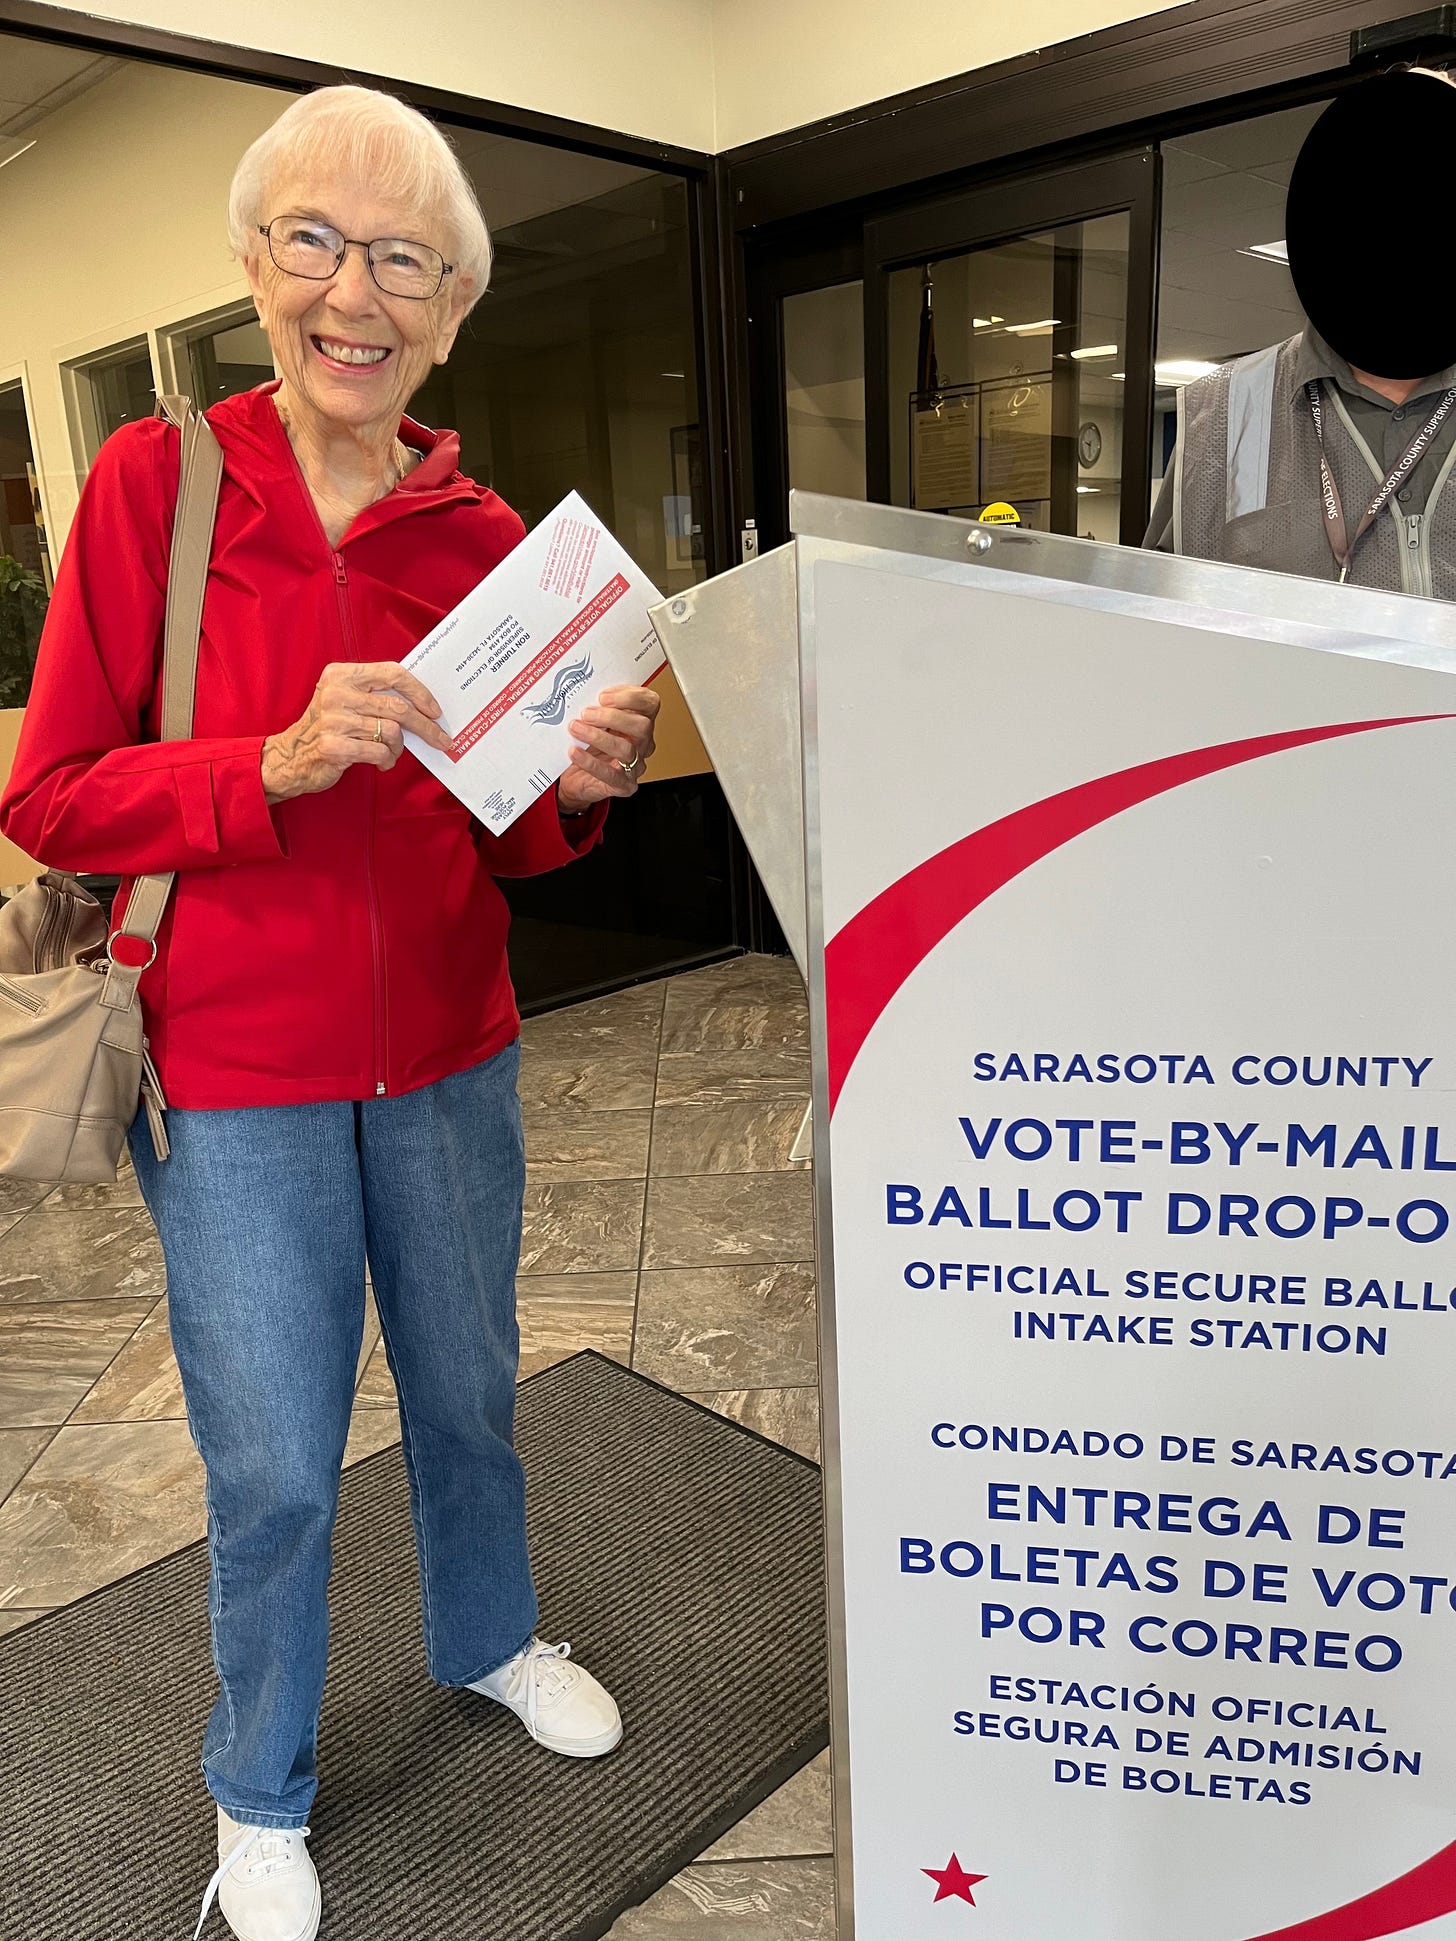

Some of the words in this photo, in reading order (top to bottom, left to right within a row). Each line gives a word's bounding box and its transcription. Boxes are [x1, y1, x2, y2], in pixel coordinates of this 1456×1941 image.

[1368, 471, 1404, 515] SARASOTA
[1399, 433, 1428, 470] COUNTY
[1424, 386, 1456, 435] SUPERVISO
[1320, 471, 1338, 520] ELECTIONS
[982, 513, 1015, 522] AUTOMATIC
[597, 584, 624, 612] OFFICIAL
[485, 613, 513, 642] SARASOTA
[508, 619, 519, 630] PO
[561, 608, 601, 648] VOTE-BY-MAIL
[570, 603, 594, 627] OFICIALES
[478, 638, 488, 648] FL
[487, 637, 501, 651] 4194
[492, 624, 525, 658] SUPERVISOR
[498, 626, 512, 640] BOX
[513, 631, 531, 649] RON
[553, 635, 563, 645] LA
[559, 624, 574, 639] PARA
[484, 654, 495, 665] OF
[488, 645, 517, 674] TURNER
[532, 644, 565, 678] BALLOTING
[458, 661, 488, 692] ELECTIONS
[505, 674, 536, 705] MATERIAL
[507, 671, 528, 692] CORREO
[552, 668, 587, 704] ELECTION
[480, 709, 490, 719] DE
[487, 691, 508, 712] CORREO
[535, 699, 557, 721] MAIL
[463, 715, 484, 737] PRIMERA
[467, 704, 505, 743] FIRST-CLASS
[454, 739, 471, 756] MAIL
[973, 1052, 1215, 1085] SARASOTA
[1231, 1055, 1432, 1088] COUNTY
[959, 1117, 1456, 1172] VOTE-BY-MAIL
[886, 1184, 1143, 1233] BALLOT
[903, 1261, 1110, 1297] OFFICIAL
[1125, 1270, 1306, 1305] SECURE
[1324, 1277, 1456, 1312] BALL
[1014, 1311, 1174, 1345] INTAKE
[1190, 1318, 1387, 1356] STATION
[931, 1423, 1144, 1459] CONDADO
[1160, 1435, 1216, 1464] DE
[988, 1482, 1291, 1541] ENTREGA
[1317, 1505, 1406, 1549] DE
[900, 1537, 1179, 1594] BOLETAS
[1204, 1560, 1288, 1603] DE
[1313, 1568, 1456, 1615] VOT
[981, 1602, 1106, 1649] POR
[1128, 1615, 1403, 1673] CORREO
[990, 1674, 1195, 1718] ESTACIÓN
[1211, 1696, 1385, 1734] OFICIAL
[953, 1711, 1119, 1750] SEGURA
[1135, 1728, 1188, 1757] DE
[1205, 1736, 1421, 1776] ADMISIÓN
[1054, 1759, 1106, 1787] DE
[1122, 1766, 1311, 1806] BOLETAS
